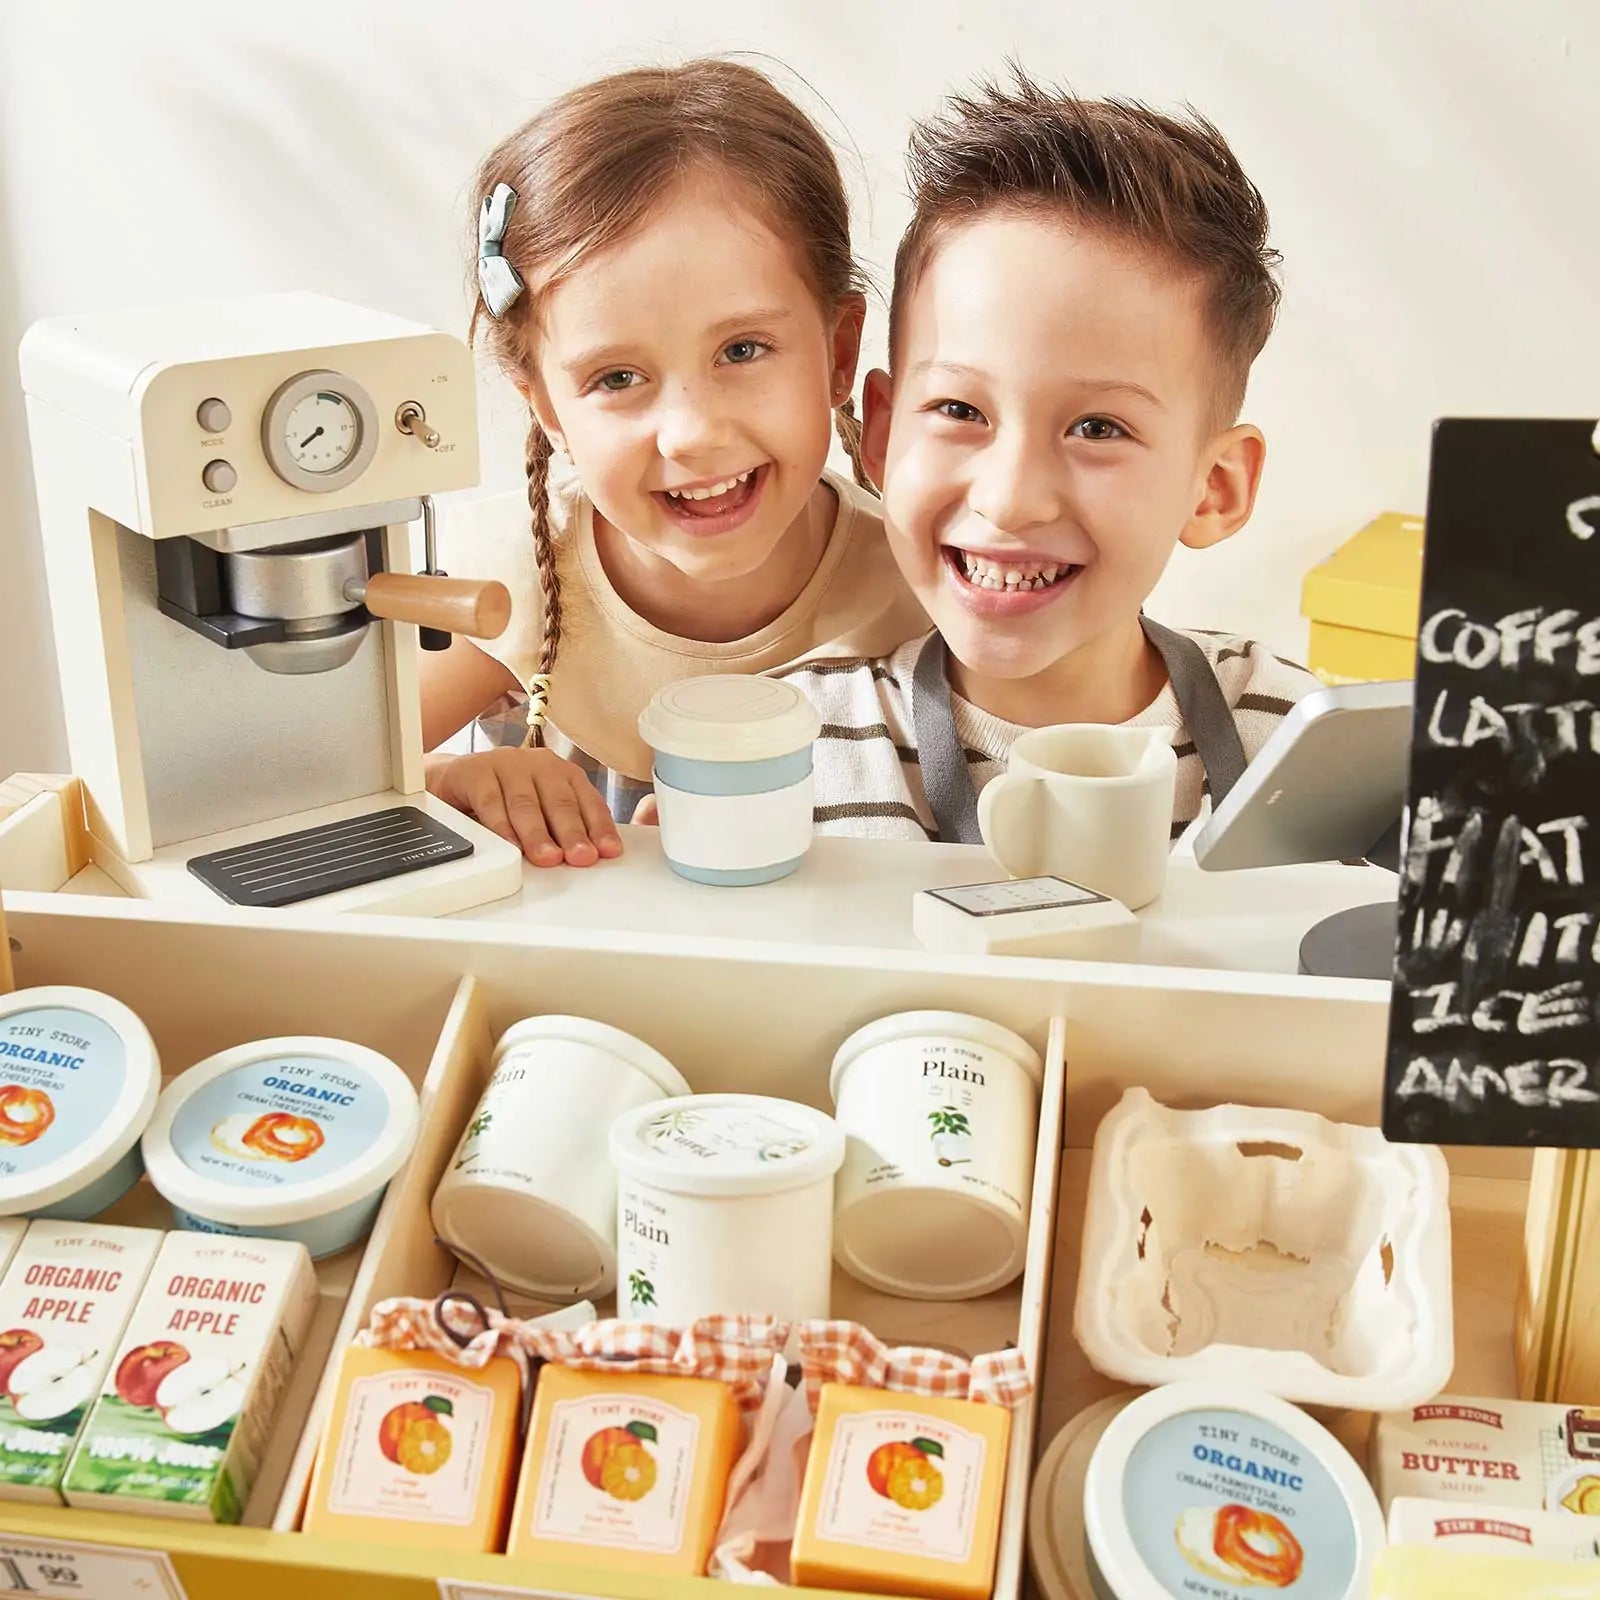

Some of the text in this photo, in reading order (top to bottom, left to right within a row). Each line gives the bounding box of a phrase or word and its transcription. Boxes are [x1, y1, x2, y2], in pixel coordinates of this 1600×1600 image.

[203, 497, 233, 509] CLEAN
[402, 845, 453, 862] TINY LAND
[1409, 980, 1589, 1034] ICE
[8, 1025, 91, 1050] TINY STORE
[0, 1041, 85, 1070] ORGANIC
[280, 1065, 360, 1091] TINY STORE
[922, 1060, 986, 1087] Plain
[263, 1076, 355, 1107] ORGANIC
[624, 1209, 671, 1245] Plain
[24, 1264, 122, 1293] ORGANIC
[167, 1275, 266, 1305] ORGANIC
[22, 1297, 95, 1324] APPLE
[167, 1309, 240, 1336] APPLE
[1419, 1406, 1499, 1426] TINY STORE
[1199, 1425, 1300, 1466] TINY STORE
[1176, 1469, 1213, 1491] CREAM
[1193, 1443, 1304, 1492] ORGANIC
[1401, 1451, 1521, 1481] BUTTER
